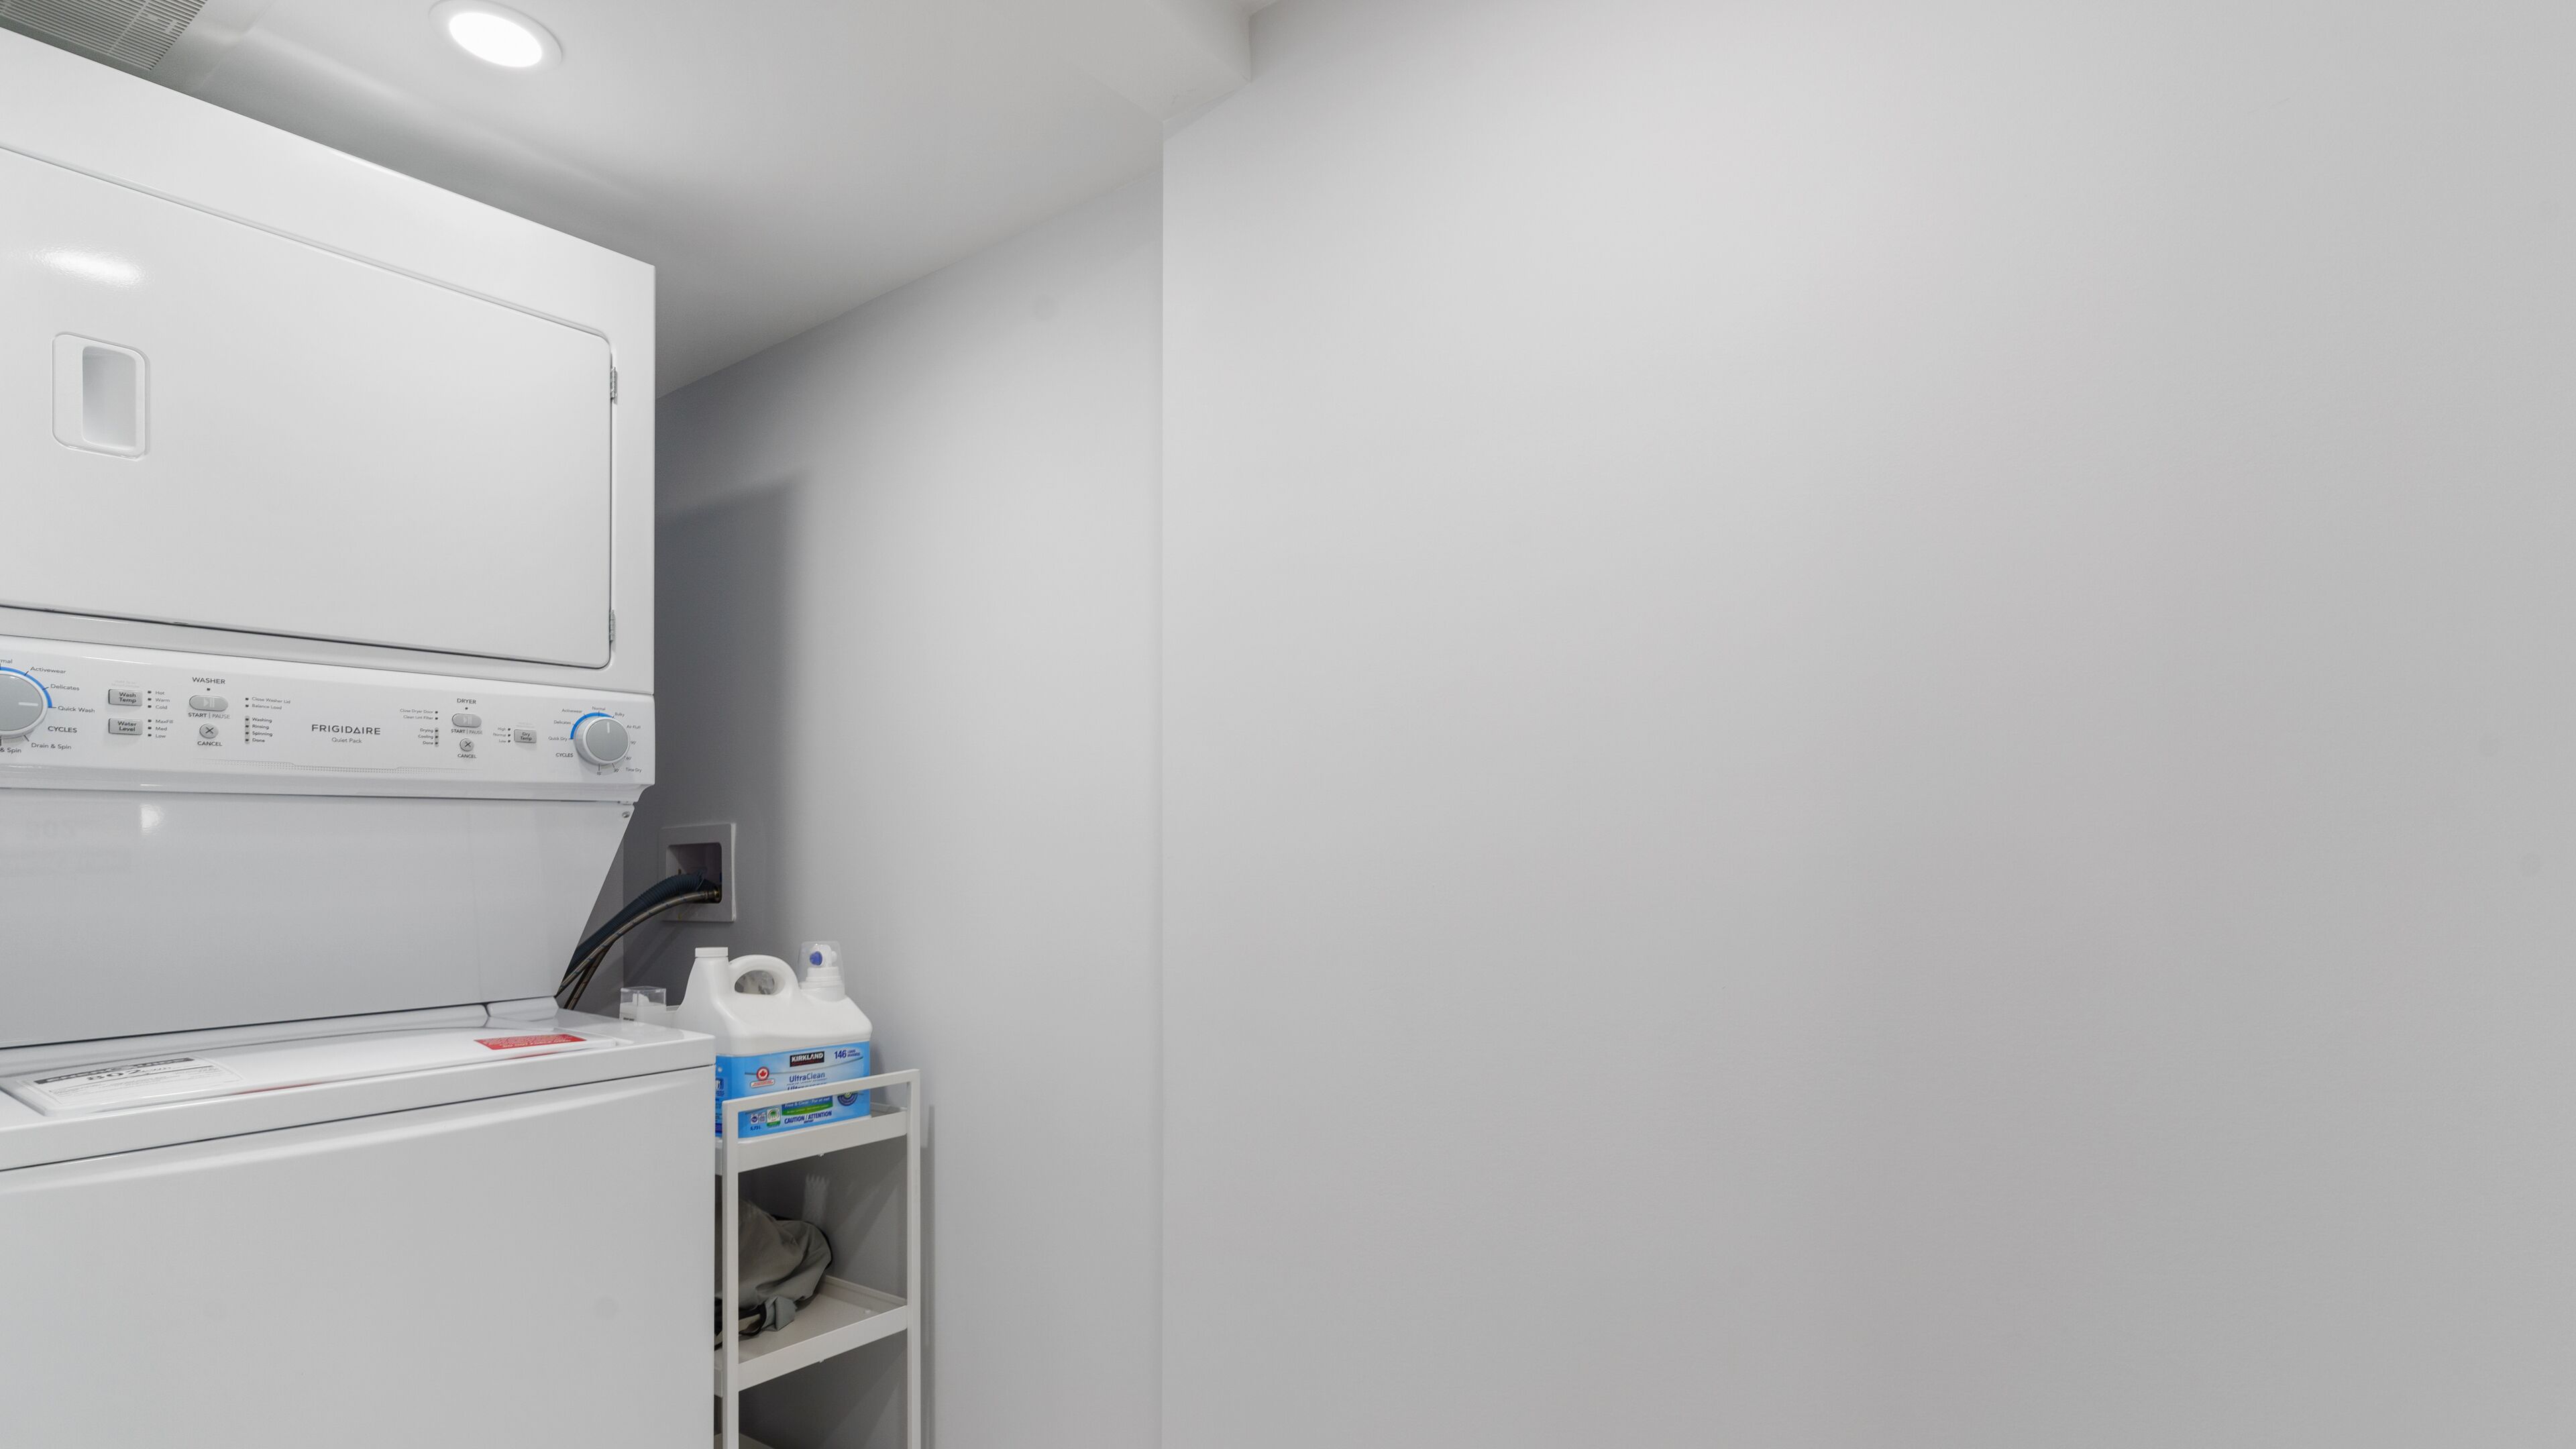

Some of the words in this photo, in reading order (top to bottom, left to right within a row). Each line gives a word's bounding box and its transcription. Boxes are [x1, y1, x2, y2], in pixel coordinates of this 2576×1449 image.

[30, 666, 66, 674] Activewear
[311, 724, 381, 735] FRIGIDAIRE
[791, 1053, 824, 1063] KIRKLAND
[834, 1049, 847, 1059] 146
[784, 1115, 805, 1124] CAUTION
[808, 1111, 833, 1120] ATTENTION
